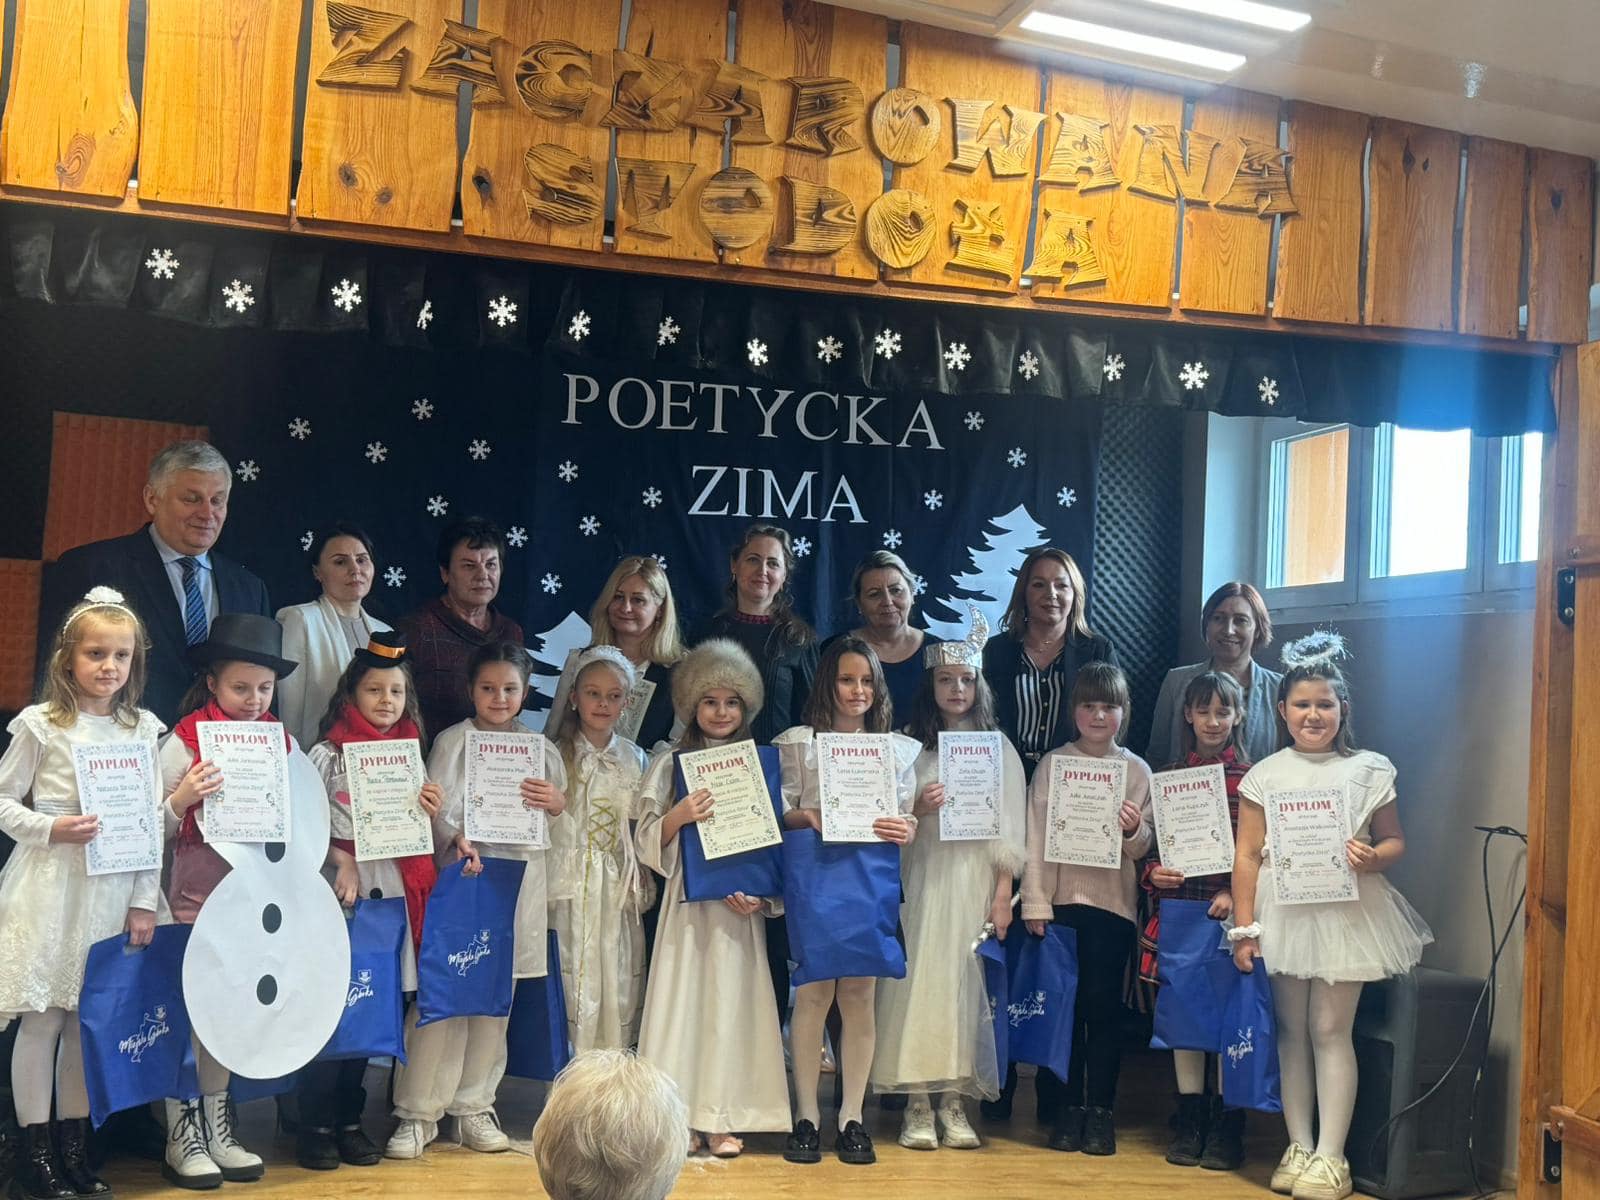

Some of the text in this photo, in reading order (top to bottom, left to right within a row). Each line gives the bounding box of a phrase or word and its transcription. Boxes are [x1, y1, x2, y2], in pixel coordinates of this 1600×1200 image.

[316, 1, 1300, 216] ZACZAROWANA
[522, 142, 1108, 288] STODOŁA
[561, 373, 945, 450] POETYCKA
[687, 465, 868, 524] ZIMA
[214, 733, 268, 745] DYPLOM
[480, 743, 529, 756] DYPLOM
[831, 747, 879, 757] DYPLOM
[951, 746, 991, 756] DYPLOM
[88, 758, 139, 771] DYPLOM
[360, 755, 408, 767] DYPLOM
[696, 757, 745, 775] DYPLOM
[1064, 770, 1112, 783] DYPLOM
[1163, 780, 1211, 795] DYPLOM
[1280, 800, 1332, 812] DYPLOM
